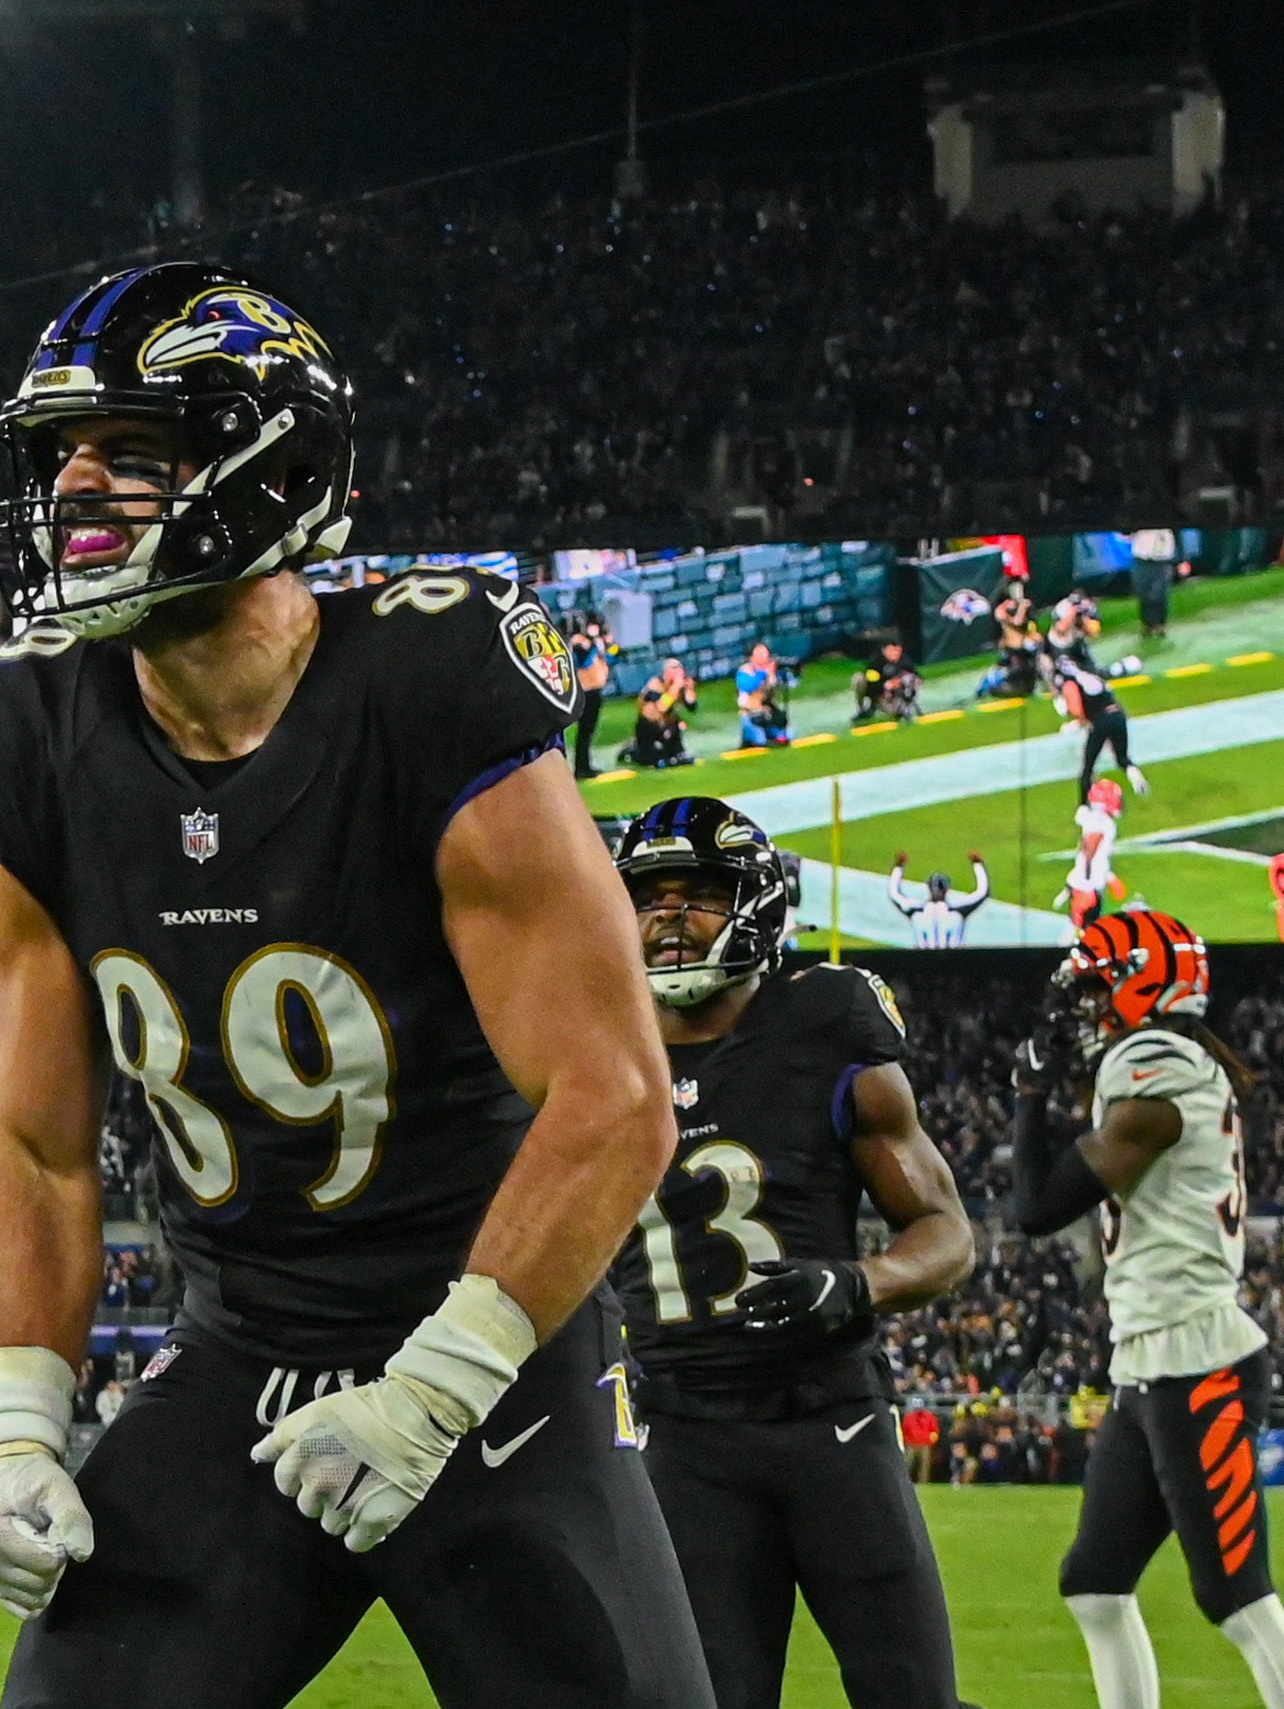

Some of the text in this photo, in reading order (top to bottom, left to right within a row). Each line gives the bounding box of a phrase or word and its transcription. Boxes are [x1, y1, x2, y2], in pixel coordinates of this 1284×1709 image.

[158, 908, 259, 926] RAVENS
[90, 942, 397, 1212] 89
[637, 1139, 785, 1325] 13
